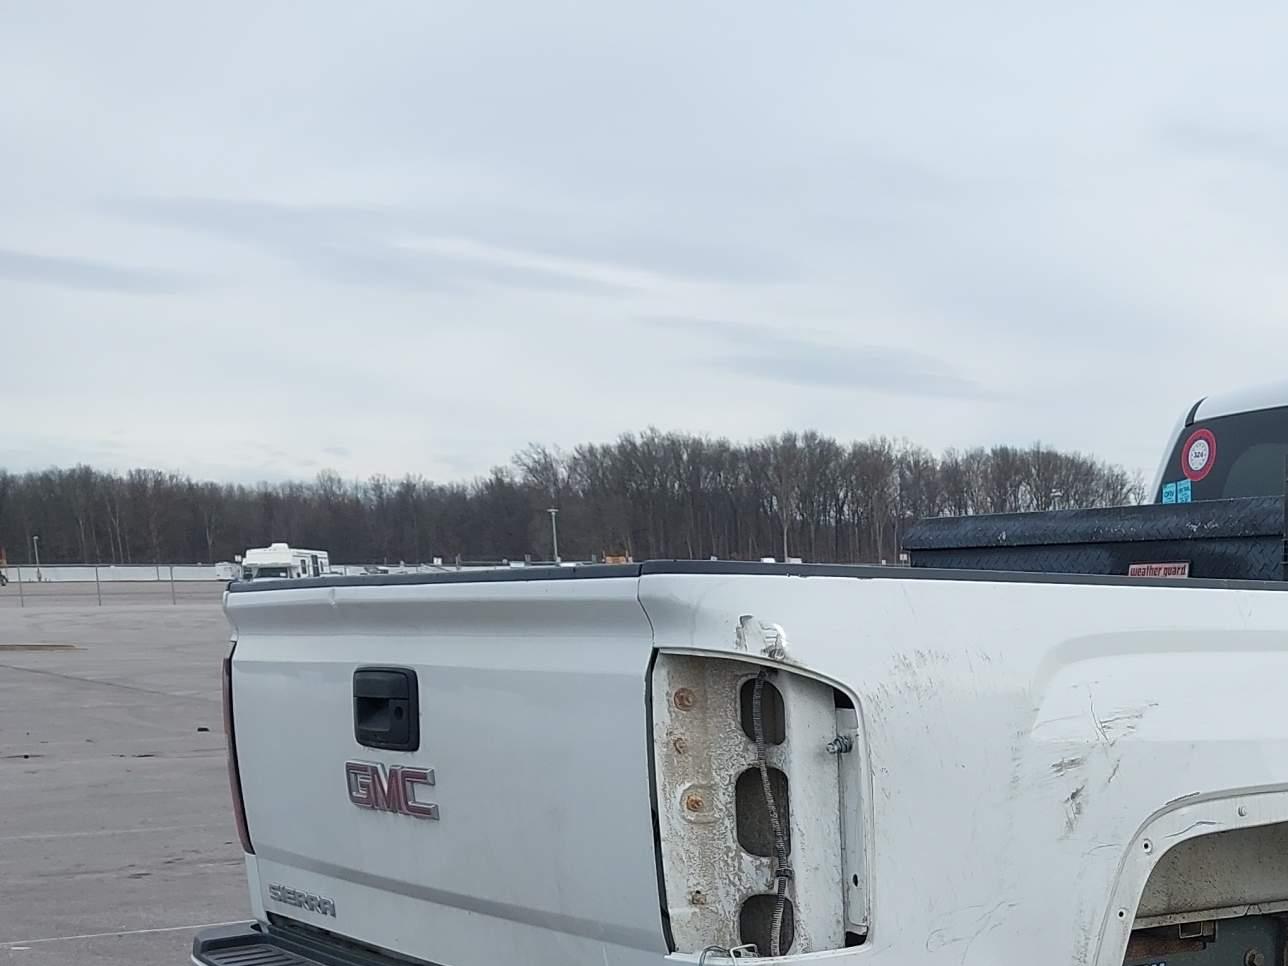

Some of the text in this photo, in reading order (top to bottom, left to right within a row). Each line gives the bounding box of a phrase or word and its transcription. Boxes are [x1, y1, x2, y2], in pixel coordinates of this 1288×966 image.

[1130, 564, 1187, 577] weather guard
[344, 758, 440, 821] GMC
[268, 881, 337, 918] SIERRA
